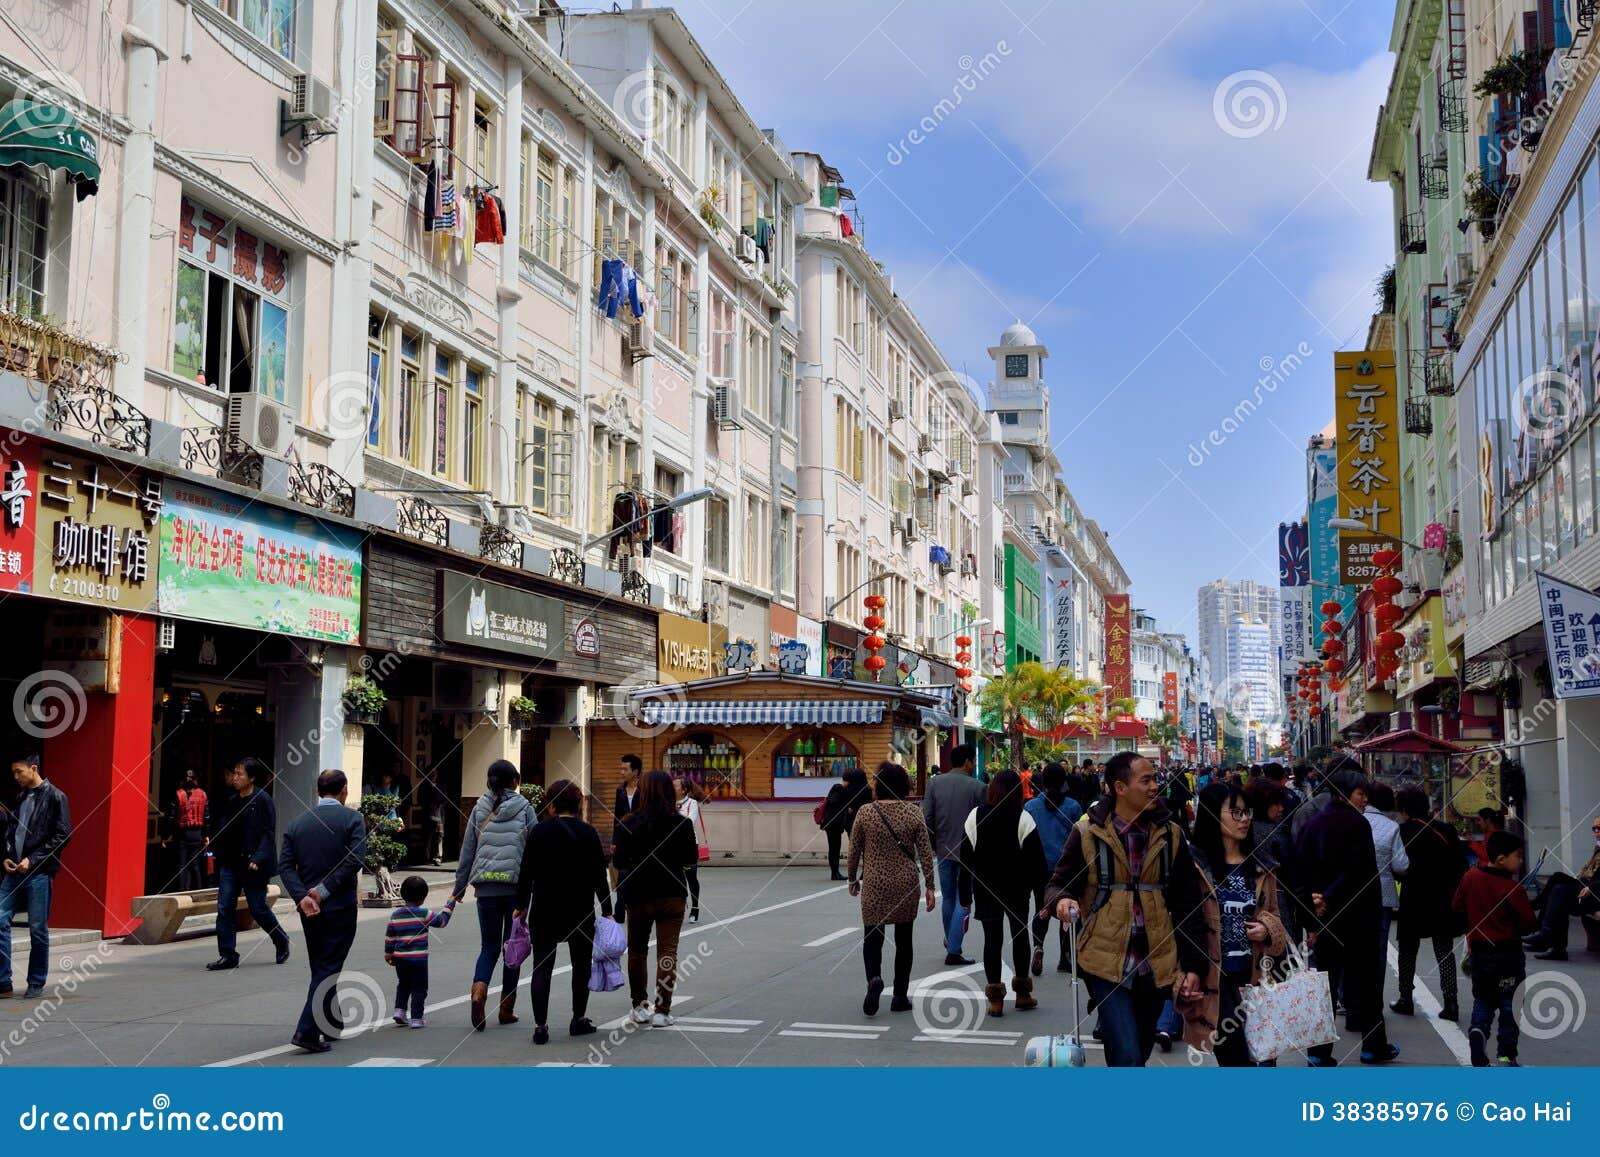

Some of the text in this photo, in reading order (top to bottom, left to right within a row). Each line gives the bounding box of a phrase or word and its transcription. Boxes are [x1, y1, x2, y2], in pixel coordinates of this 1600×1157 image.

[57, 131, 73, 146] 31
[1346, 383, 1390, 532] 云香茶叶
[46, 461, 166, 526] 三十一号
[57, 516, 152, 581] 咖啡馆
[63, 577, 119, 602] 2100310
[663, 639, 692, 668] YISHA
[1056, 595, 1070, 672] 让运动与众不同
[1283, 600, 1294, 661] PCD STORES
[1568, 612, 1589, 658] 欢迎您
